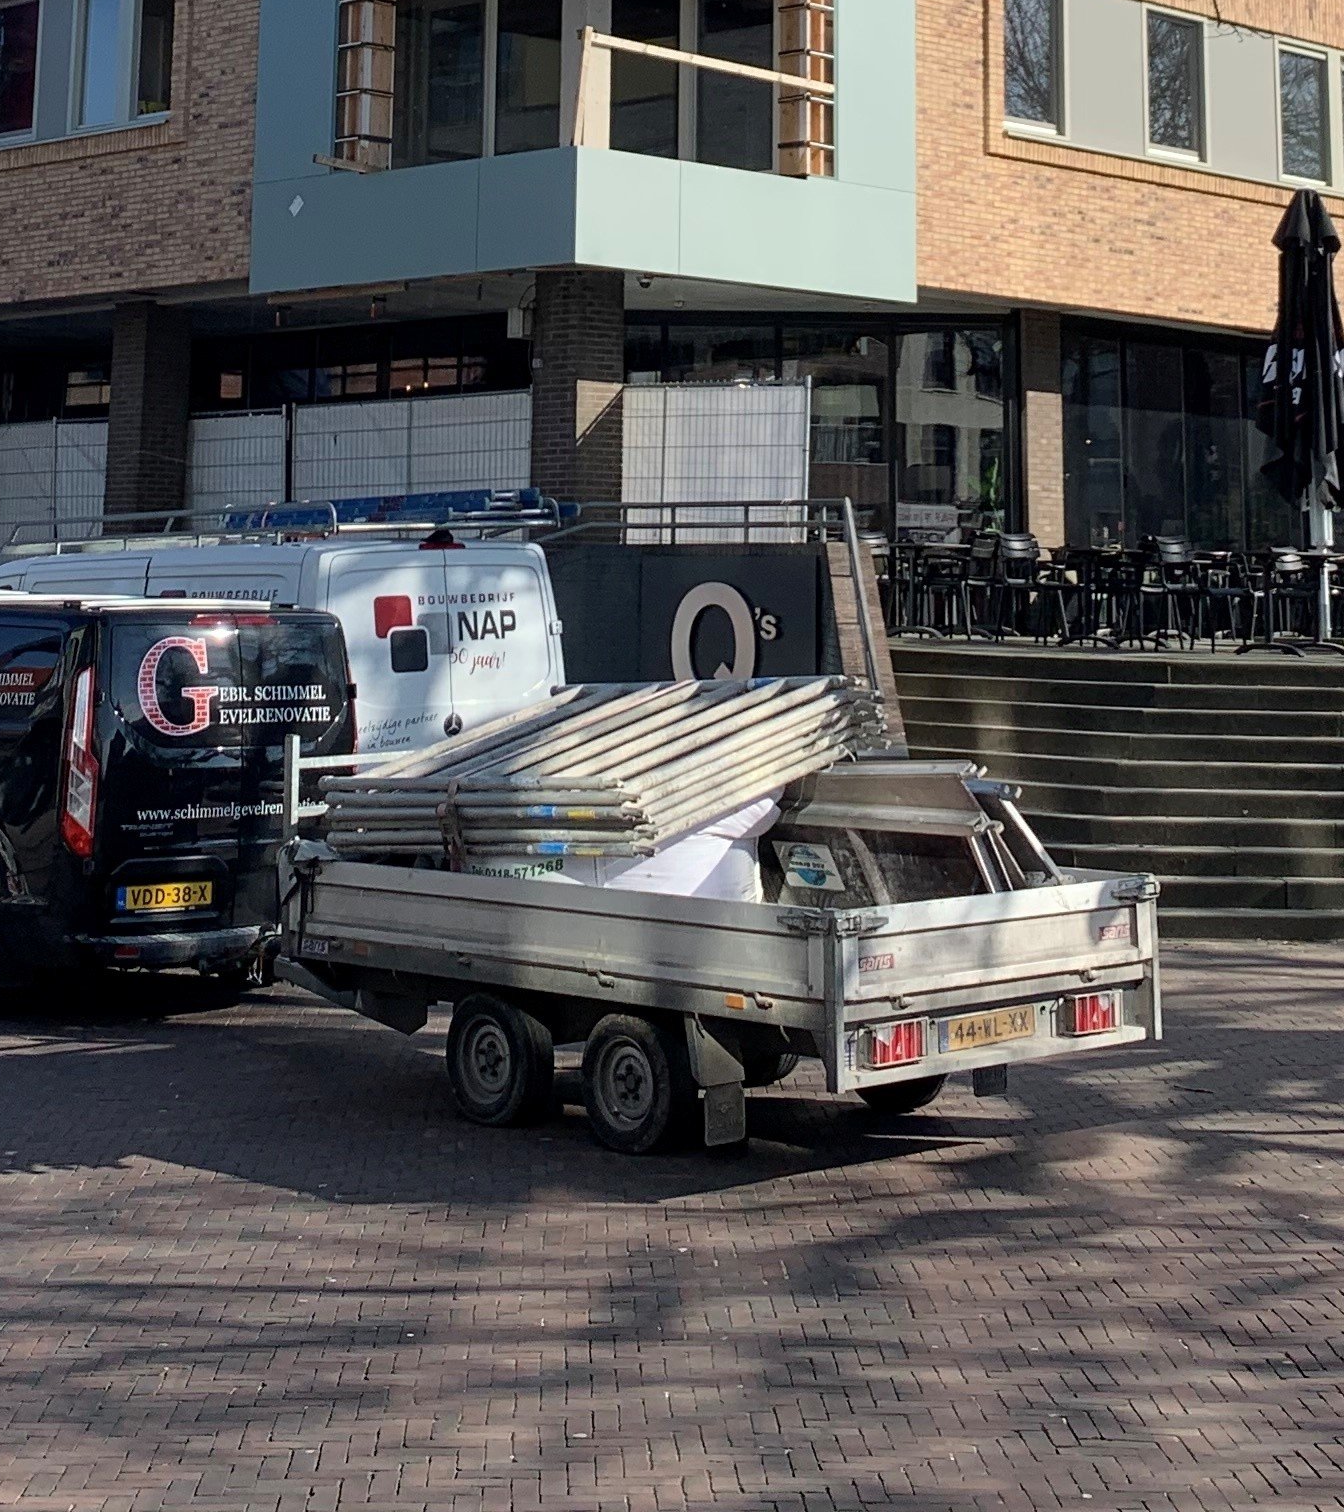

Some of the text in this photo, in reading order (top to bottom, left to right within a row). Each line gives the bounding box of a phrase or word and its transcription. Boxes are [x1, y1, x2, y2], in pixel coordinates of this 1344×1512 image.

[418, 592, 515, 605] BOUWBEDRIJF
[458, 609, 517, 642] NAP
[469, 651, 506, 675] jaar!
[255, 684, 327, 701] SCHIMMEL
[405, 712, 439, 728] partner
[367, 739, 376, 749] in
[131, 884, 208, 906] VDD-38-X
[955, 1010, 1029, 1044] 44-WL-XX
